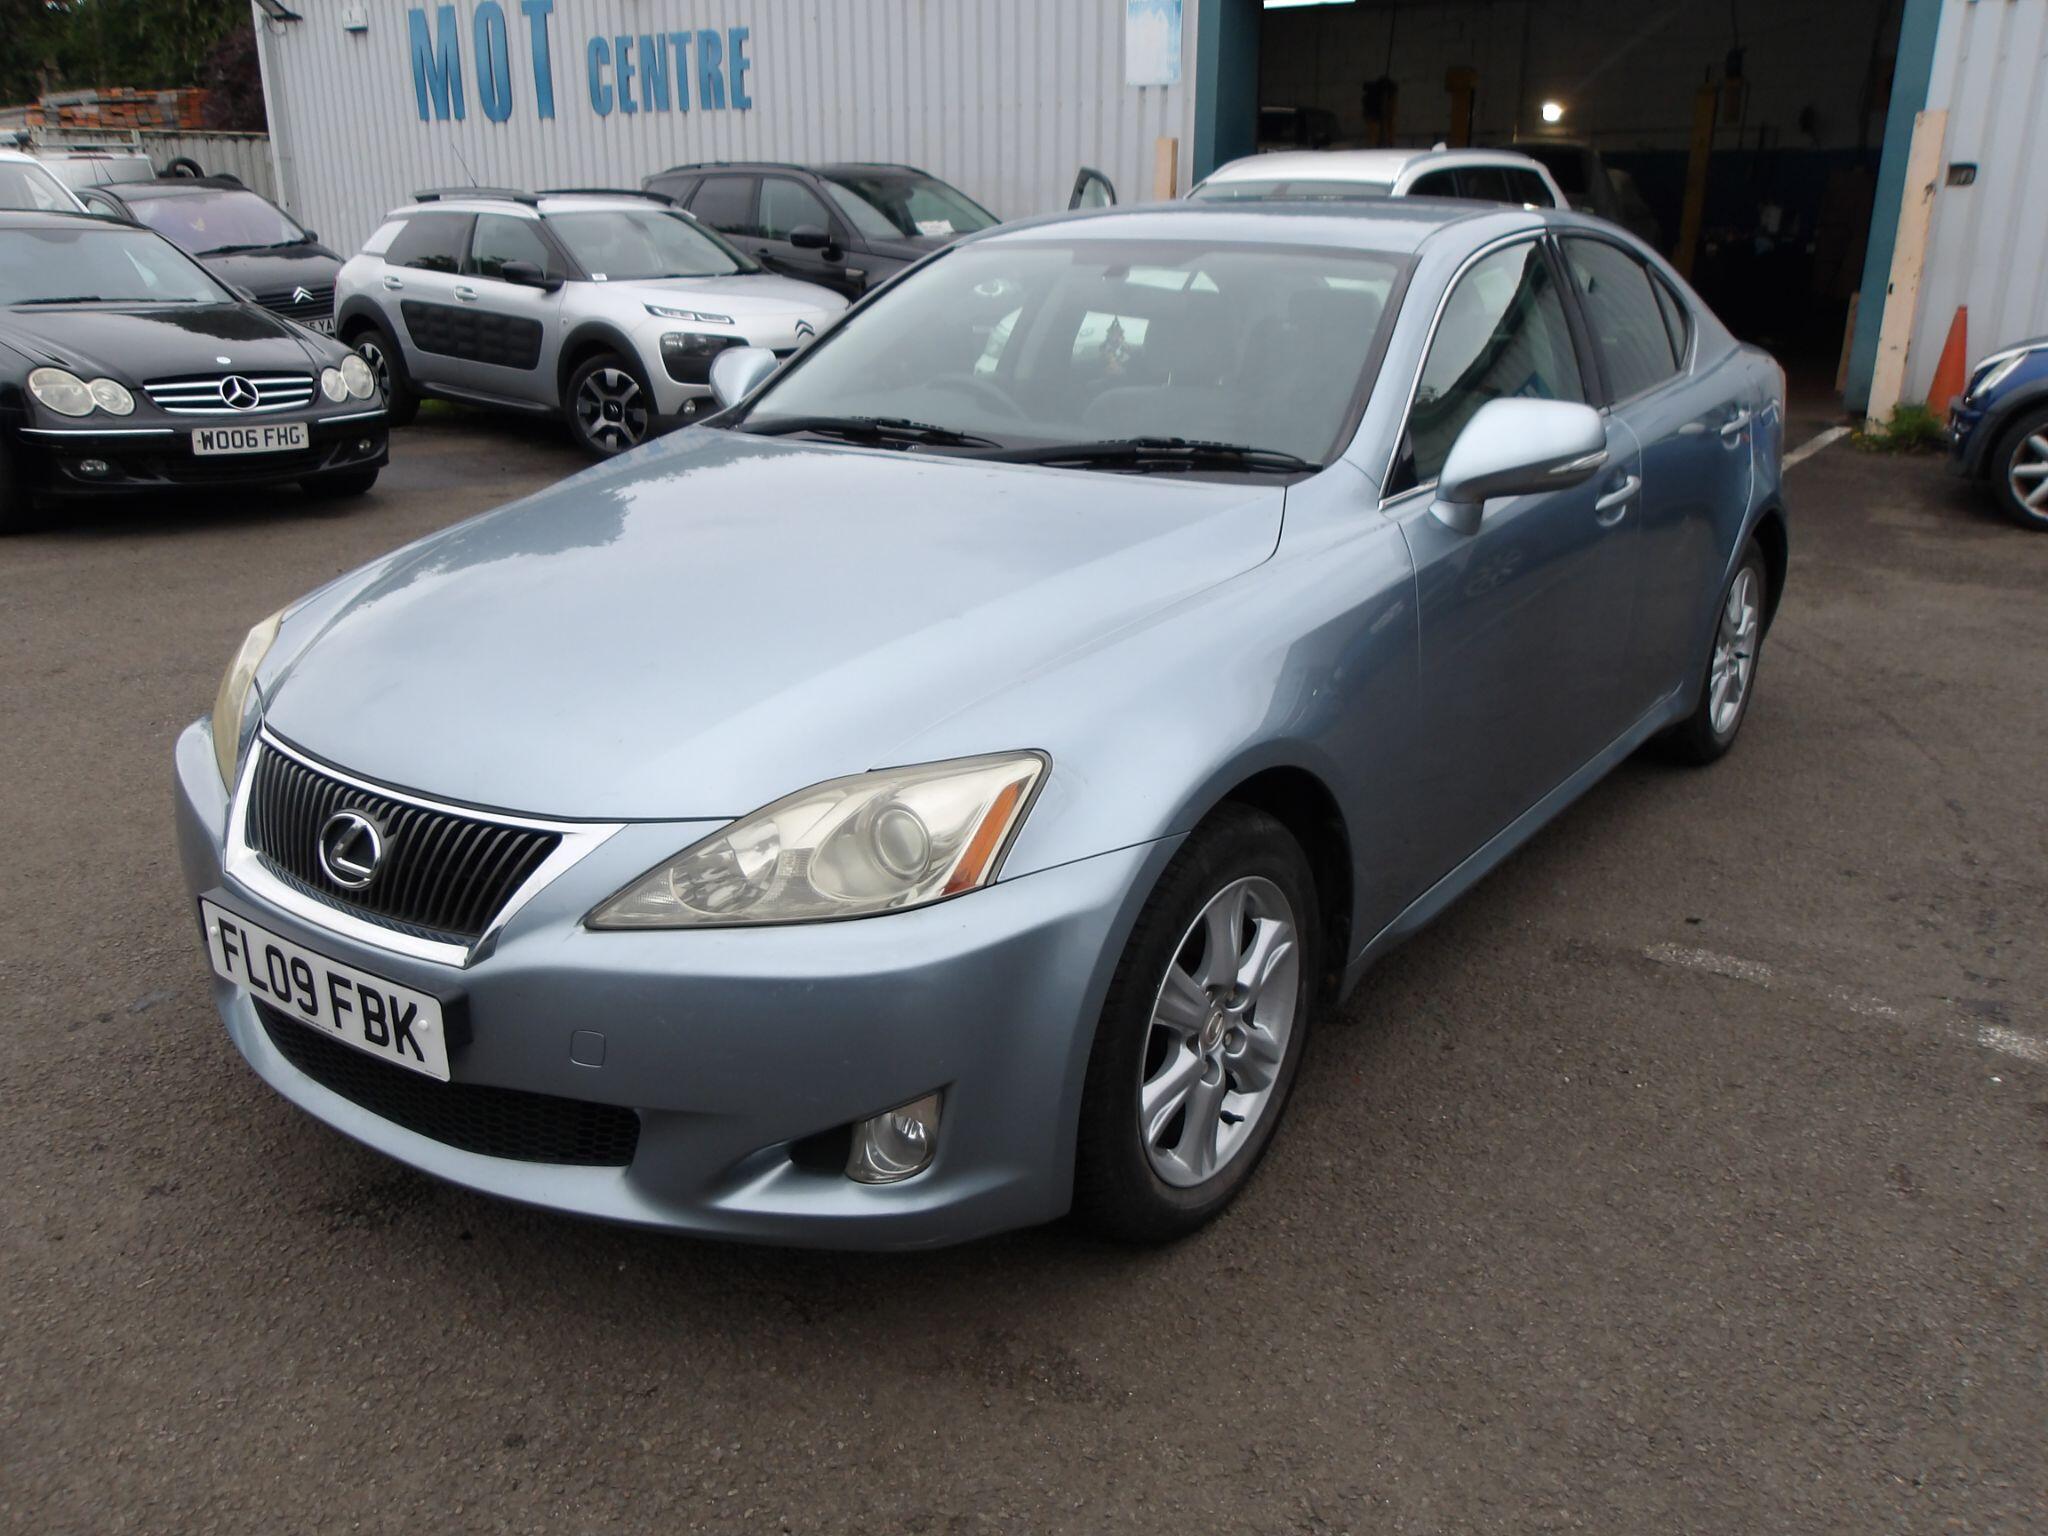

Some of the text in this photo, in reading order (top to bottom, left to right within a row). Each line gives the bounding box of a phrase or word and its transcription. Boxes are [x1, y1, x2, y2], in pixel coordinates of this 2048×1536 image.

[408, 0, 752, 122] MOT CENTRE
[264, 426, 300, 447] FHG
[218, 917, 425, 1062] FL09 FBK
